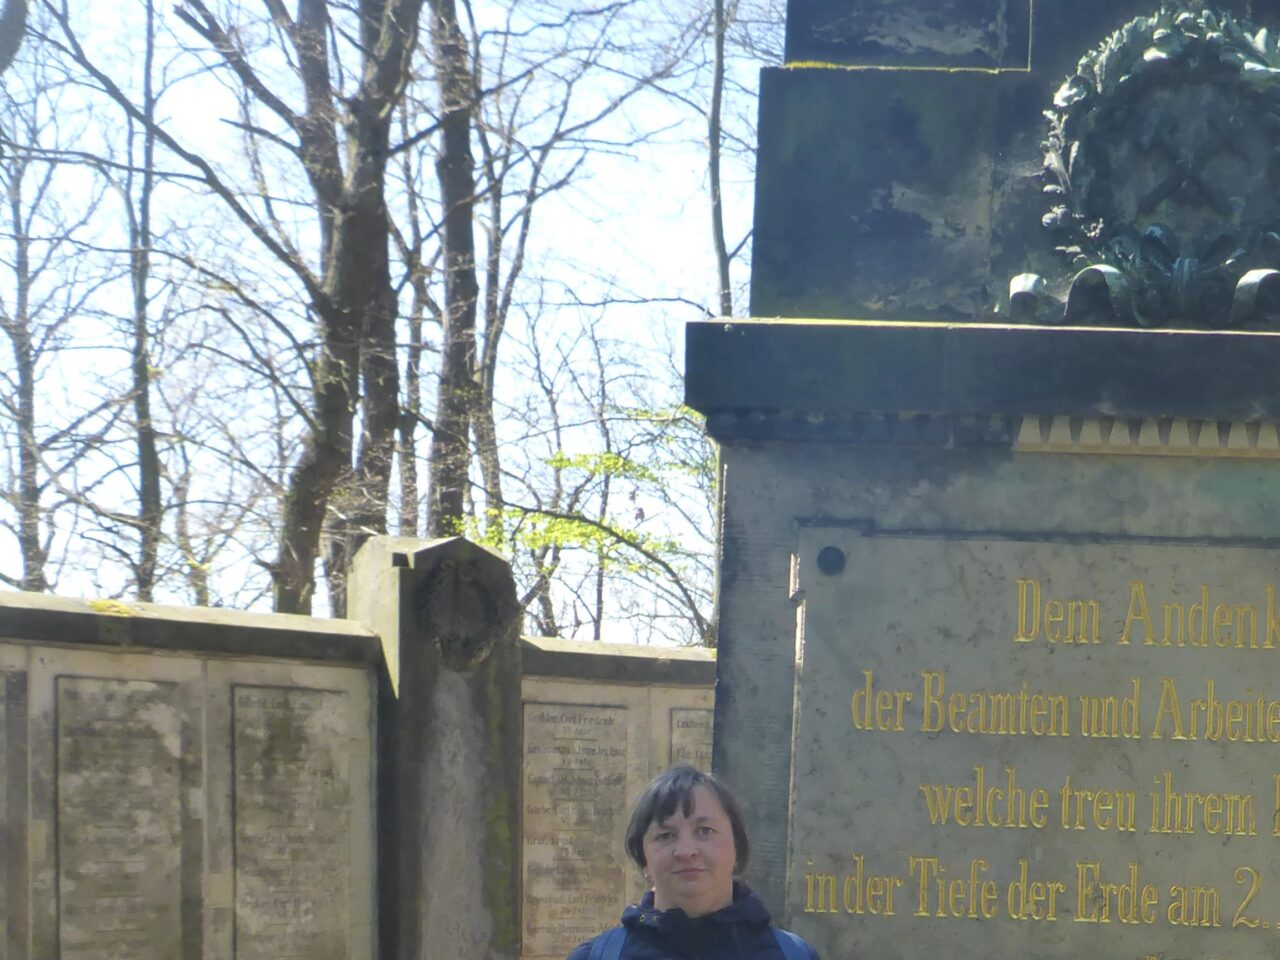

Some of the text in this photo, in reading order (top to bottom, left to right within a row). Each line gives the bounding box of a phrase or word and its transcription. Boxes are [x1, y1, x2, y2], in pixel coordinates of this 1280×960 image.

[1013, 577, 1102, 644] Dem
[851, 668, 913, 732] der
[920, 670, 1070, 737] Beamten
[1079, 676, 1141, 739] und
[918, 765, 1050, 829] welche
[1059, 775, 1138, 832] treu
[1148, 769, 1258, 837] ihrem
[803, 858, 839, 914] in
[843, 853, 904, 915] der
[908, 855, 999, 919] Tiefe
[1006, 858, 1066, 922] der
[1073, 860, 1159, 925] Erde
[1166, 884, 1222, 928] am
[1231, 866, 1271, 930] 2.
